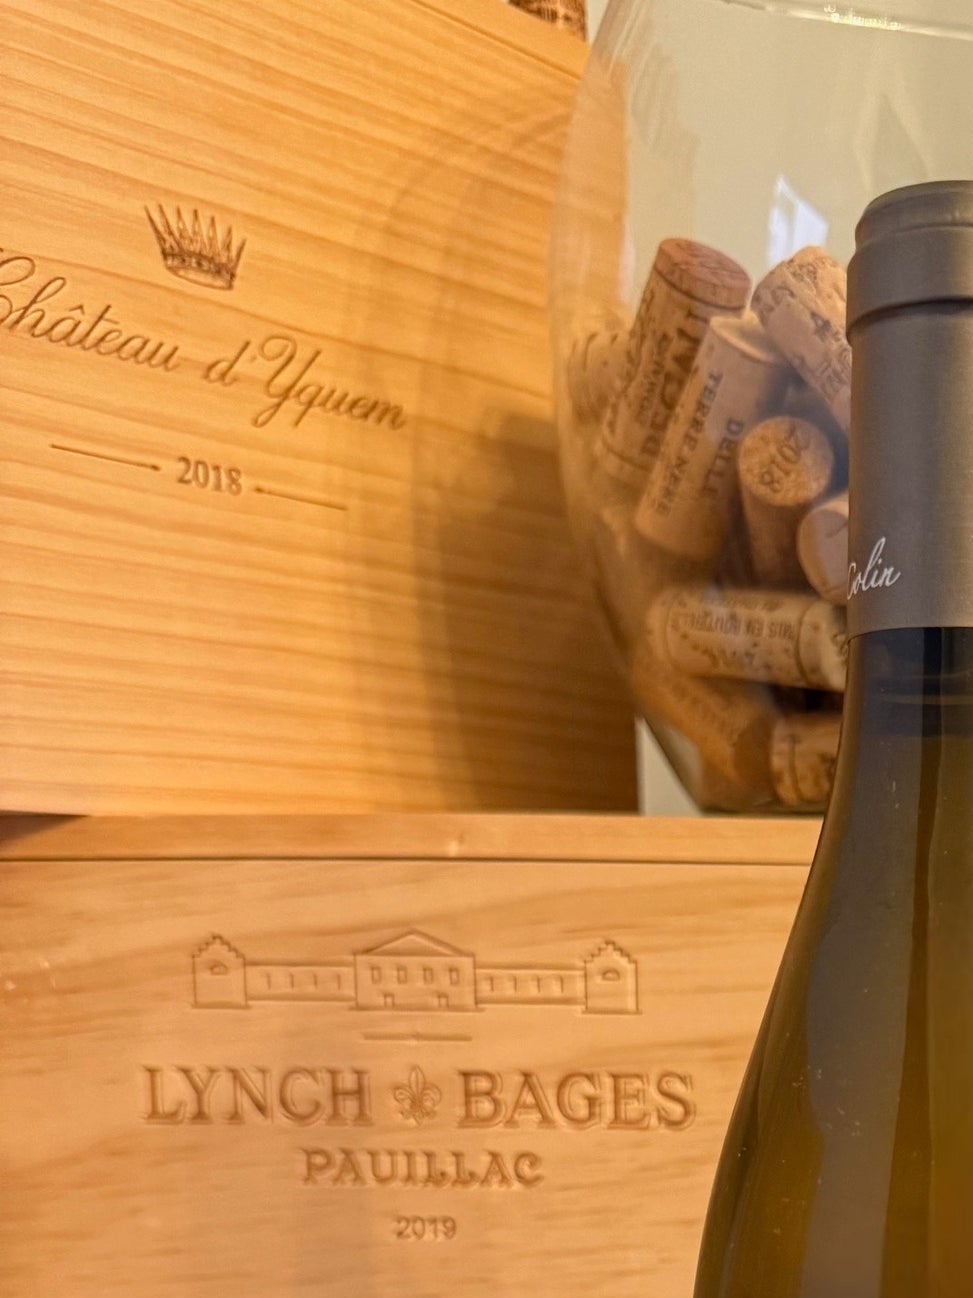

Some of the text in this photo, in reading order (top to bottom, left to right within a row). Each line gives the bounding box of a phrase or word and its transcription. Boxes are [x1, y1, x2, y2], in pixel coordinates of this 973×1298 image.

[203, 334, 407, 432] d'Yquem
[177, 457, 242, 497] 2018
[846, 536, 902, 600] Colin
[143, 1065, 697, 1131] LYNCH BAGES
[301, 1147, 545, 1188] PAUILLAC
[395, 1215, 458, 1241] 2019
